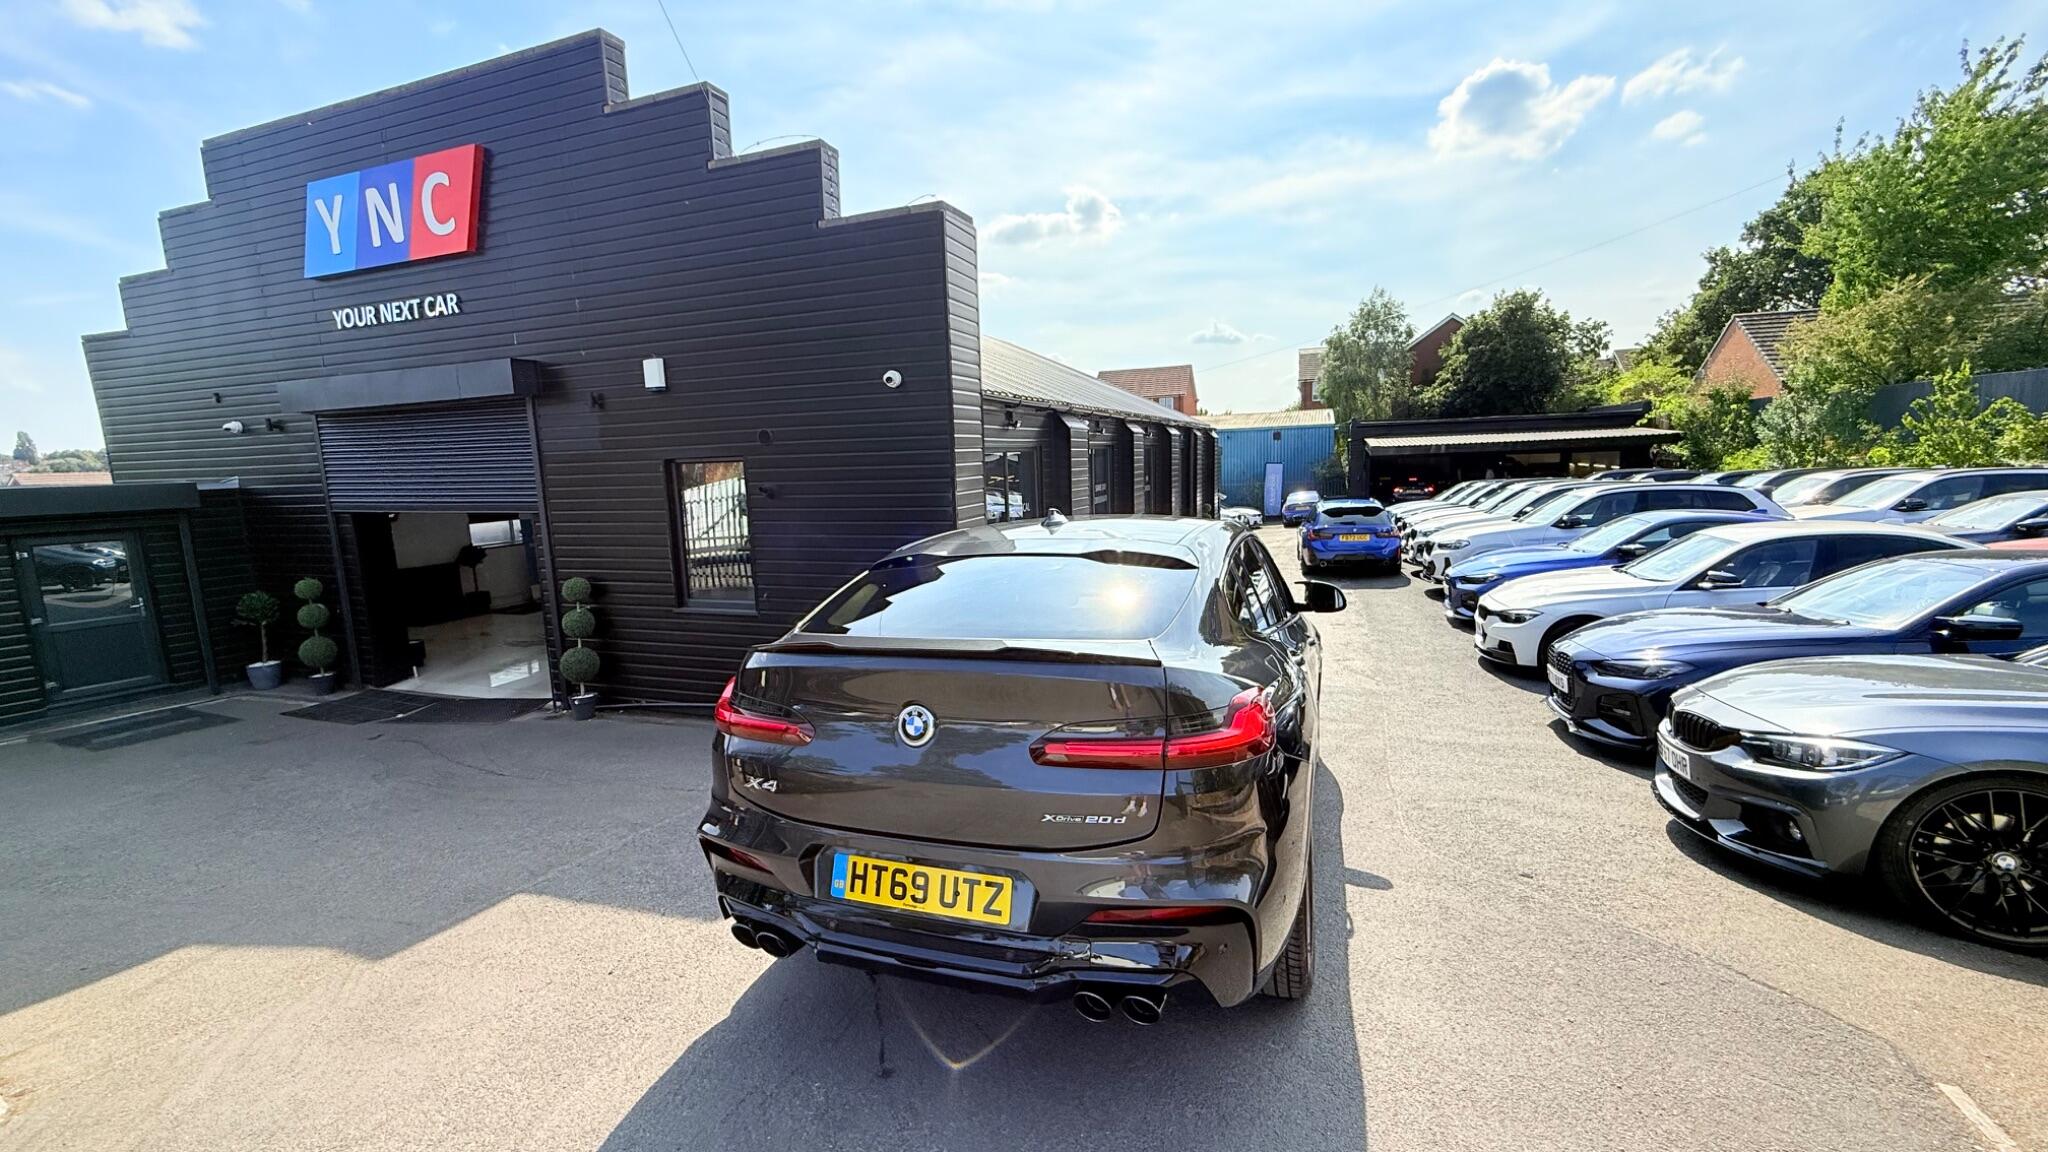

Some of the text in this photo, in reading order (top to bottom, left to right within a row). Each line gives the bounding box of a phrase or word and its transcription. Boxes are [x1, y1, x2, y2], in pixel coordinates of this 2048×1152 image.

[314, 171, 456, 255] YNC
[332, 293, 460, 330] YOUR NEXT CAR
[743, 775, 778, 792] X4
[849, 860, 1005, 917] HT69 UTZ
